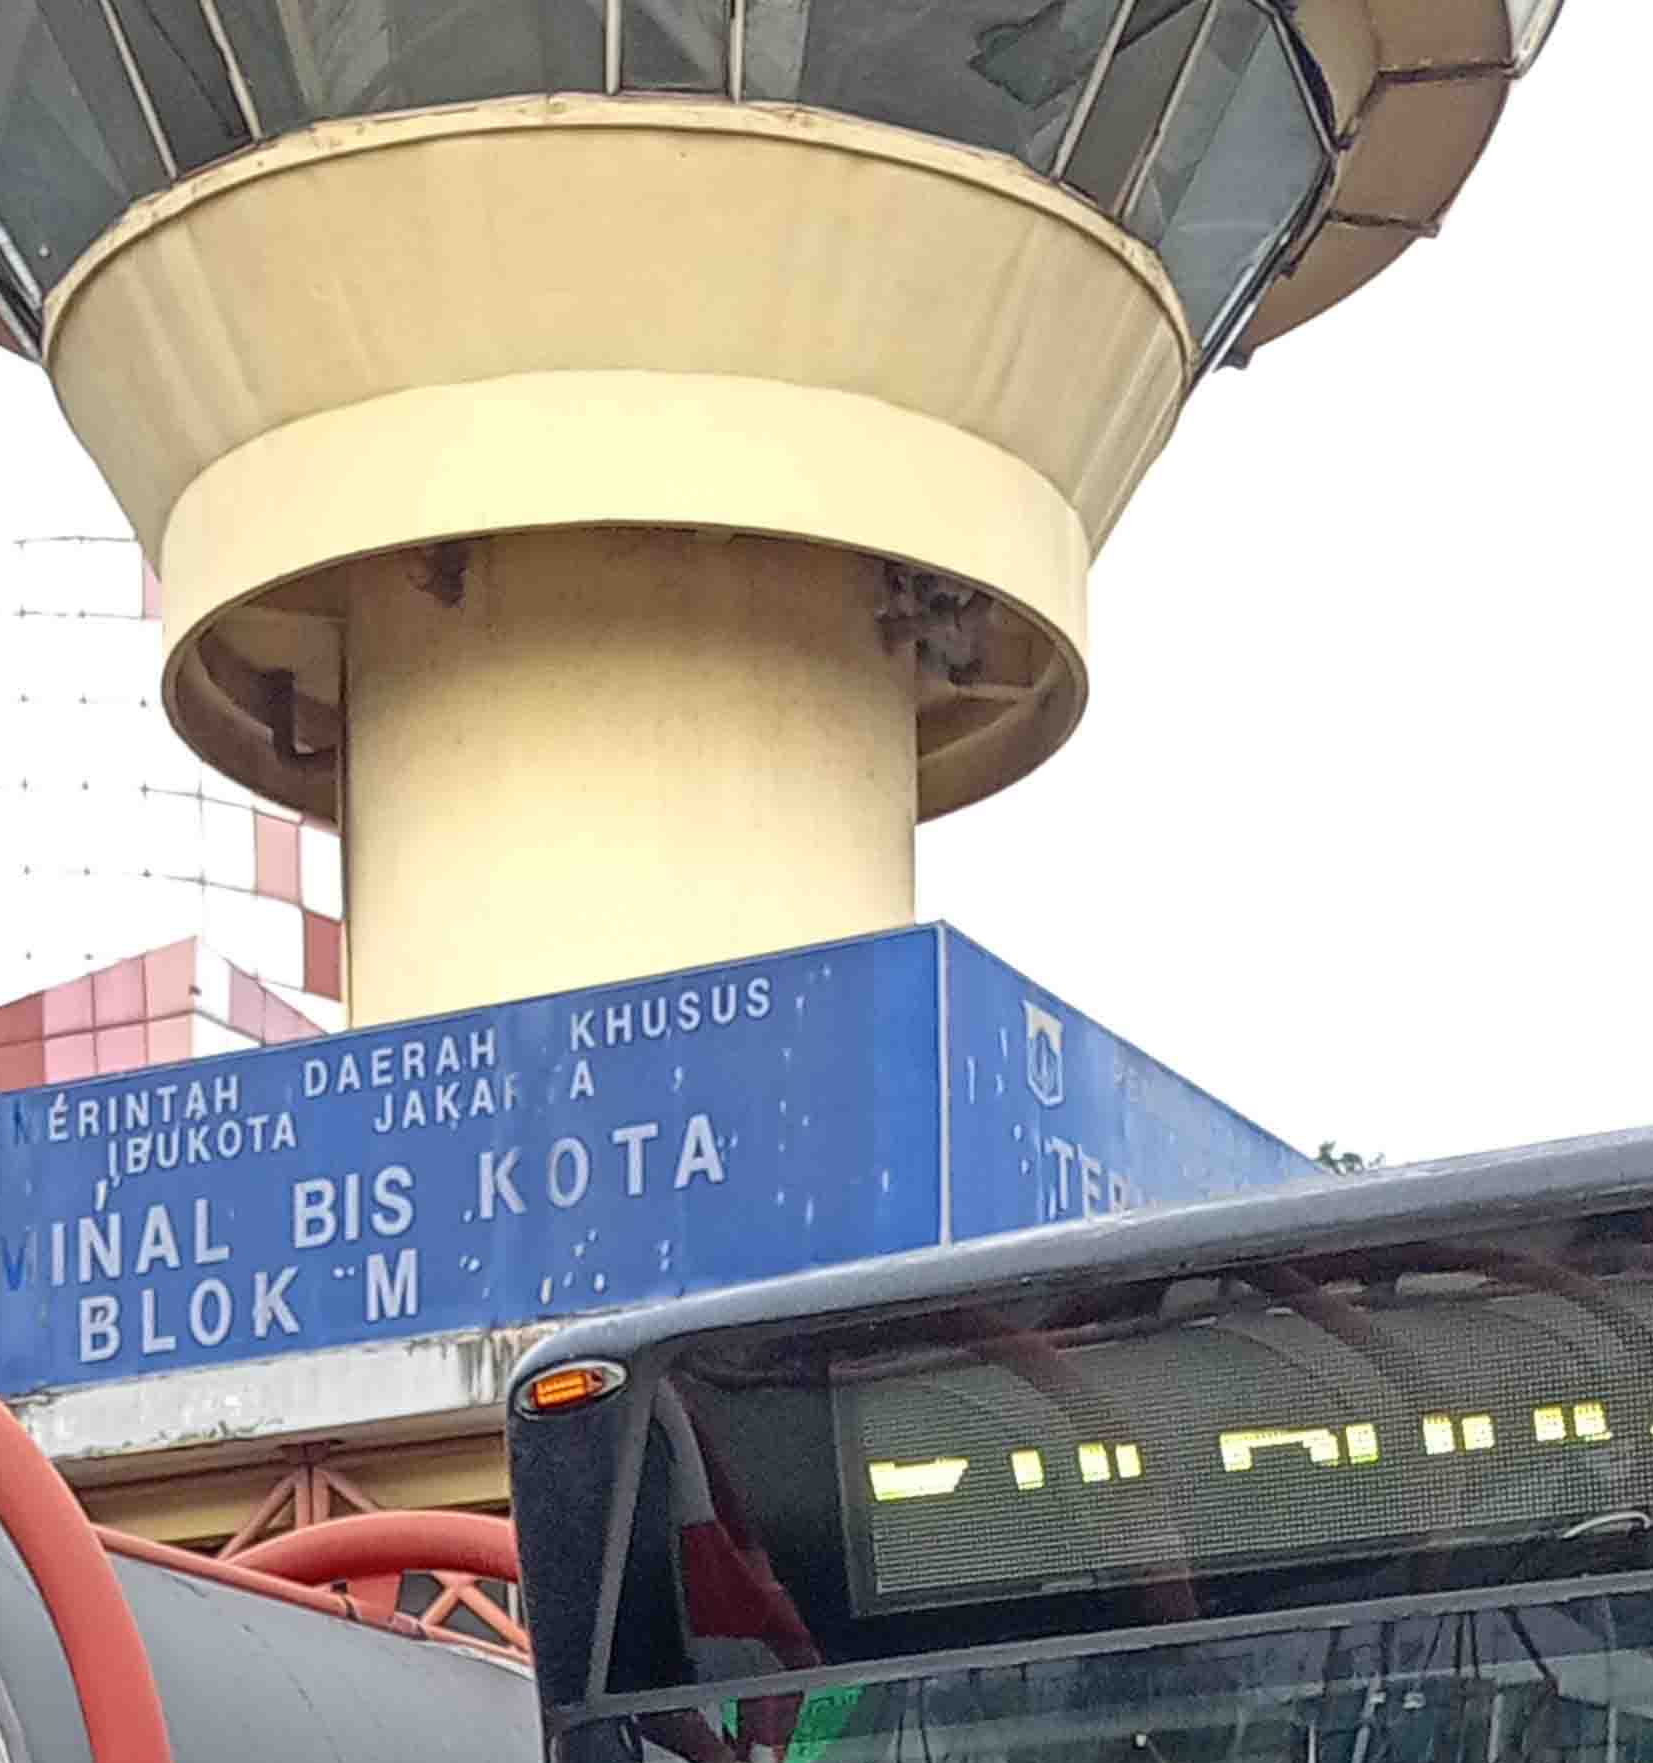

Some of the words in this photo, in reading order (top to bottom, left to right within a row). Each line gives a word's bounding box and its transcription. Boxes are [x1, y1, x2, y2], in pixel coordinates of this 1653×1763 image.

[303, 1027, 498, 1098] DAERAH
[570, 976, 772, 1052] KHUSUS
[108, 1112, 297, 1173] IBUKOTA
[291, 1165, 414, 1249] BIS
[477, 1112, 724, 1221] KOTA
[77, 1265, 301, 1363] BLOK
[365, 1247, 419, 1322] M
